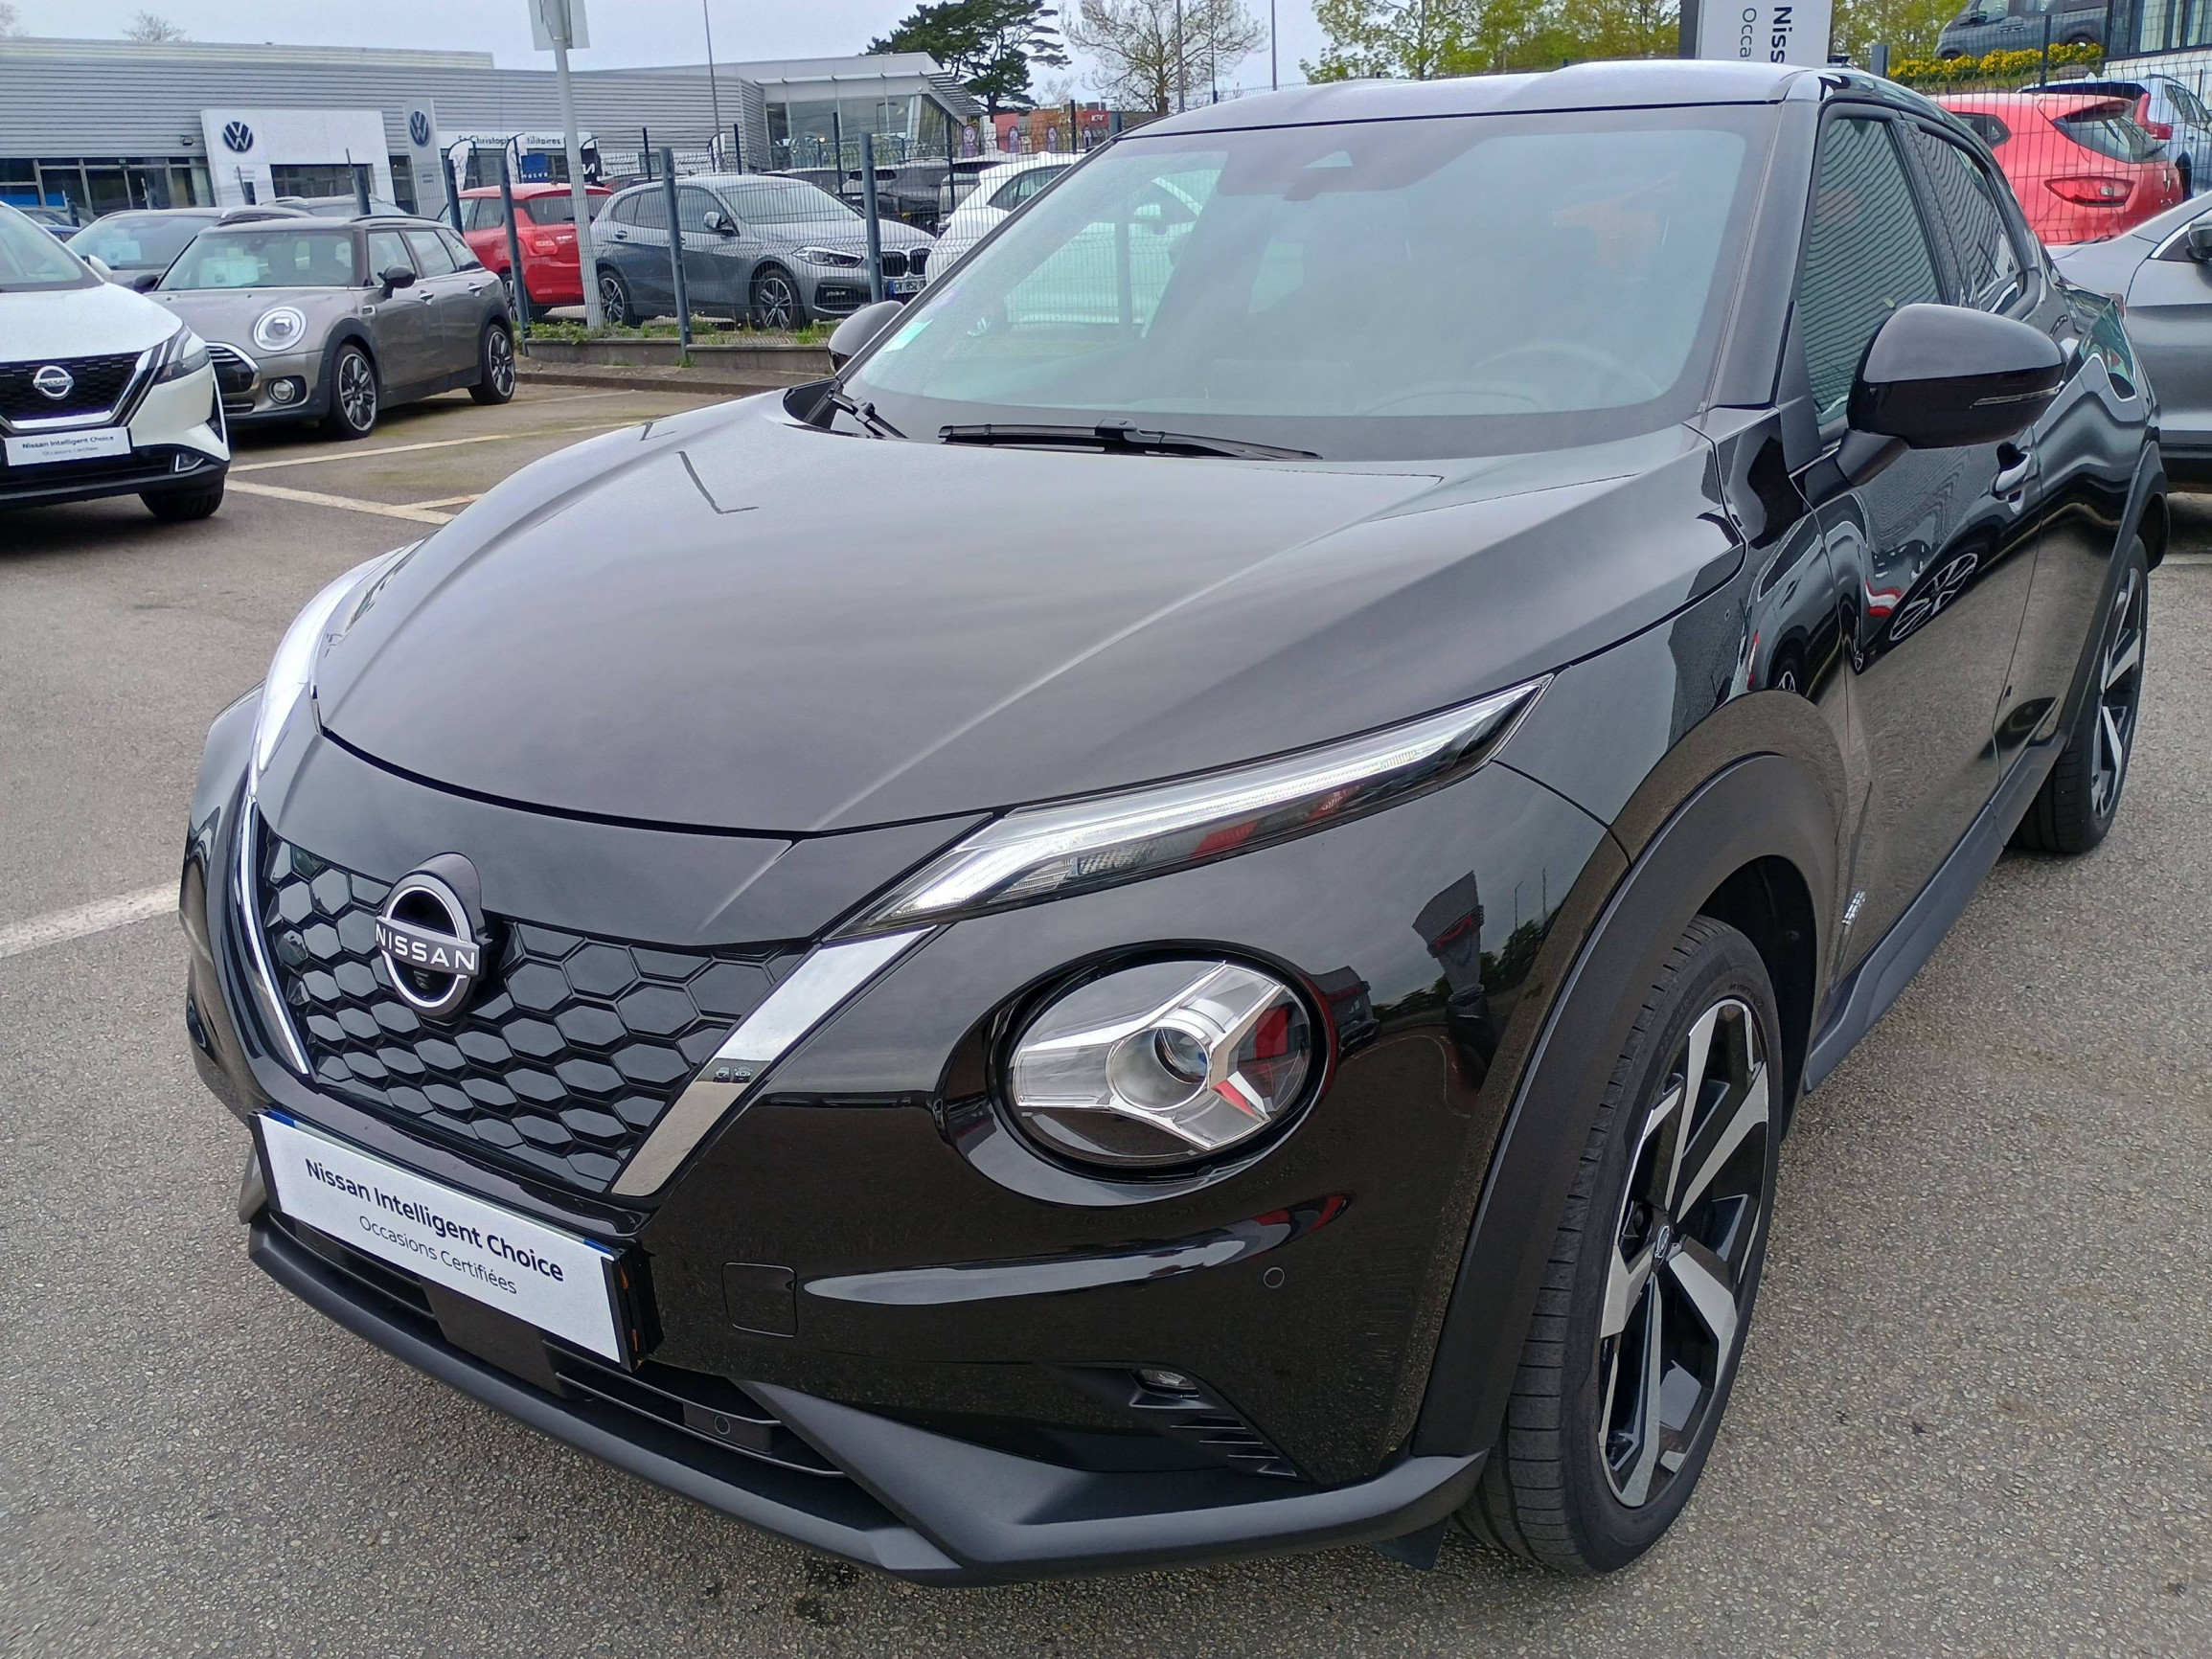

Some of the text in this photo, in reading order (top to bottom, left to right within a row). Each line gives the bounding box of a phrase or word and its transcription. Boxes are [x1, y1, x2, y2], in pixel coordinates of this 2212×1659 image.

[1740, 8, 1757, 58] Occa
[1770, 6, 1792, 63] Niss
[50, 437, 88, 445] Intelligent
[376, 922, 475, 971] NISSAN
[305, 1158, 564, 1283] Nissan Intelligent Choice
[358, 1216, 518, 1295] Occasions Certifiées
